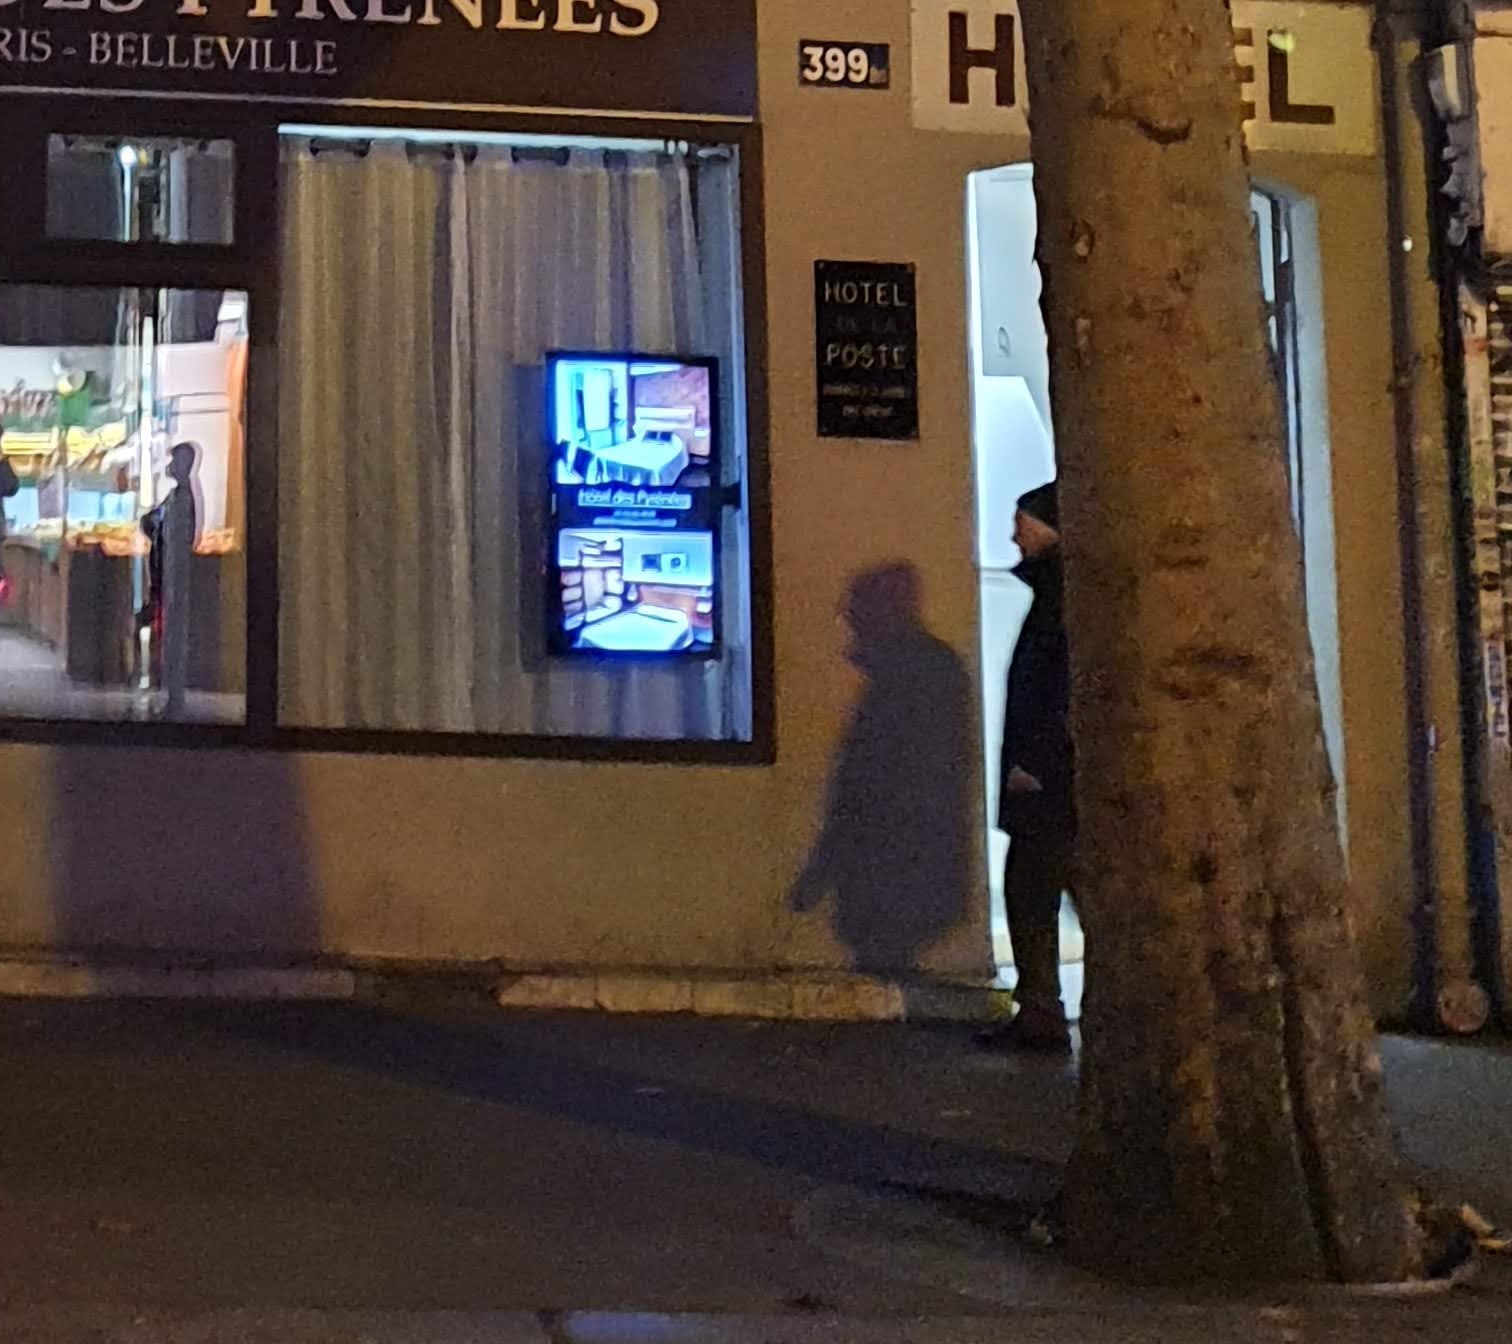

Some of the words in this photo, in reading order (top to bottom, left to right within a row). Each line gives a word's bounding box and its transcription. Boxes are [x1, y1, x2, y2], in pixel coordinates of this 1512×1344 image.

[89, 33, 338, 75] BELLEVILLE
[803, 46, 868, 84] 399
[824, 281, 908, 307] HOTEL
